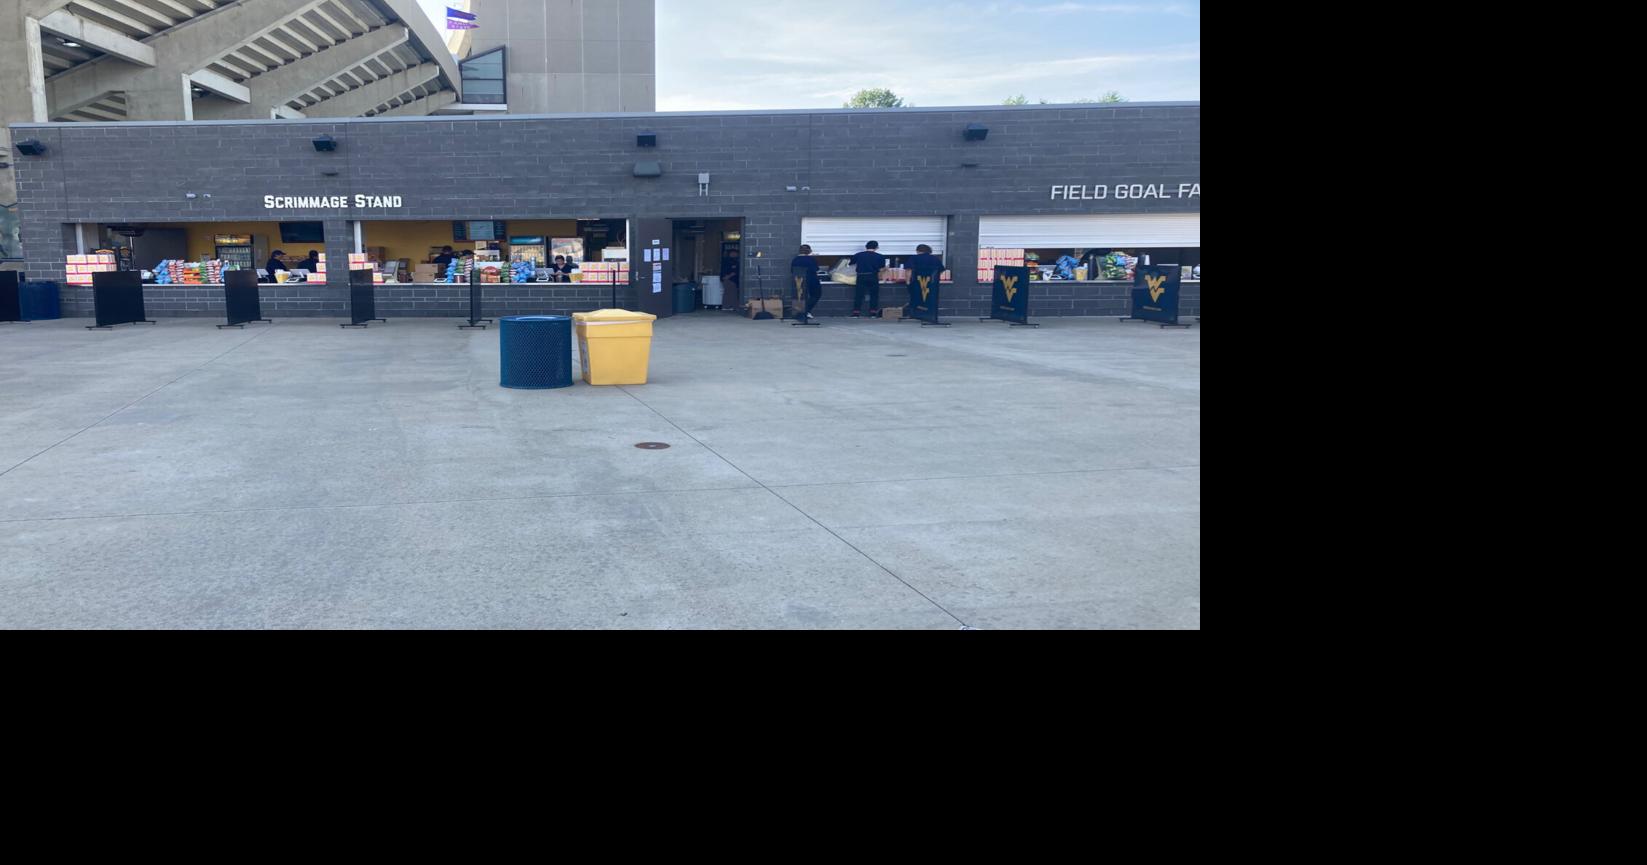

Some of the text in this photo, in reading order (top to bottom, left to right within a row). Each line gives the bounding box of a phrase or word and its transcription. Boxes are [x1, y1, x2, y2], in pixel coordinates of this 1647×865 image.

[1050, 184, 1108, 200] FIELD
[1114, 183, 1171, 199] GOAL
[263, 194, 402, 209] SCRIMMAGE STAND
